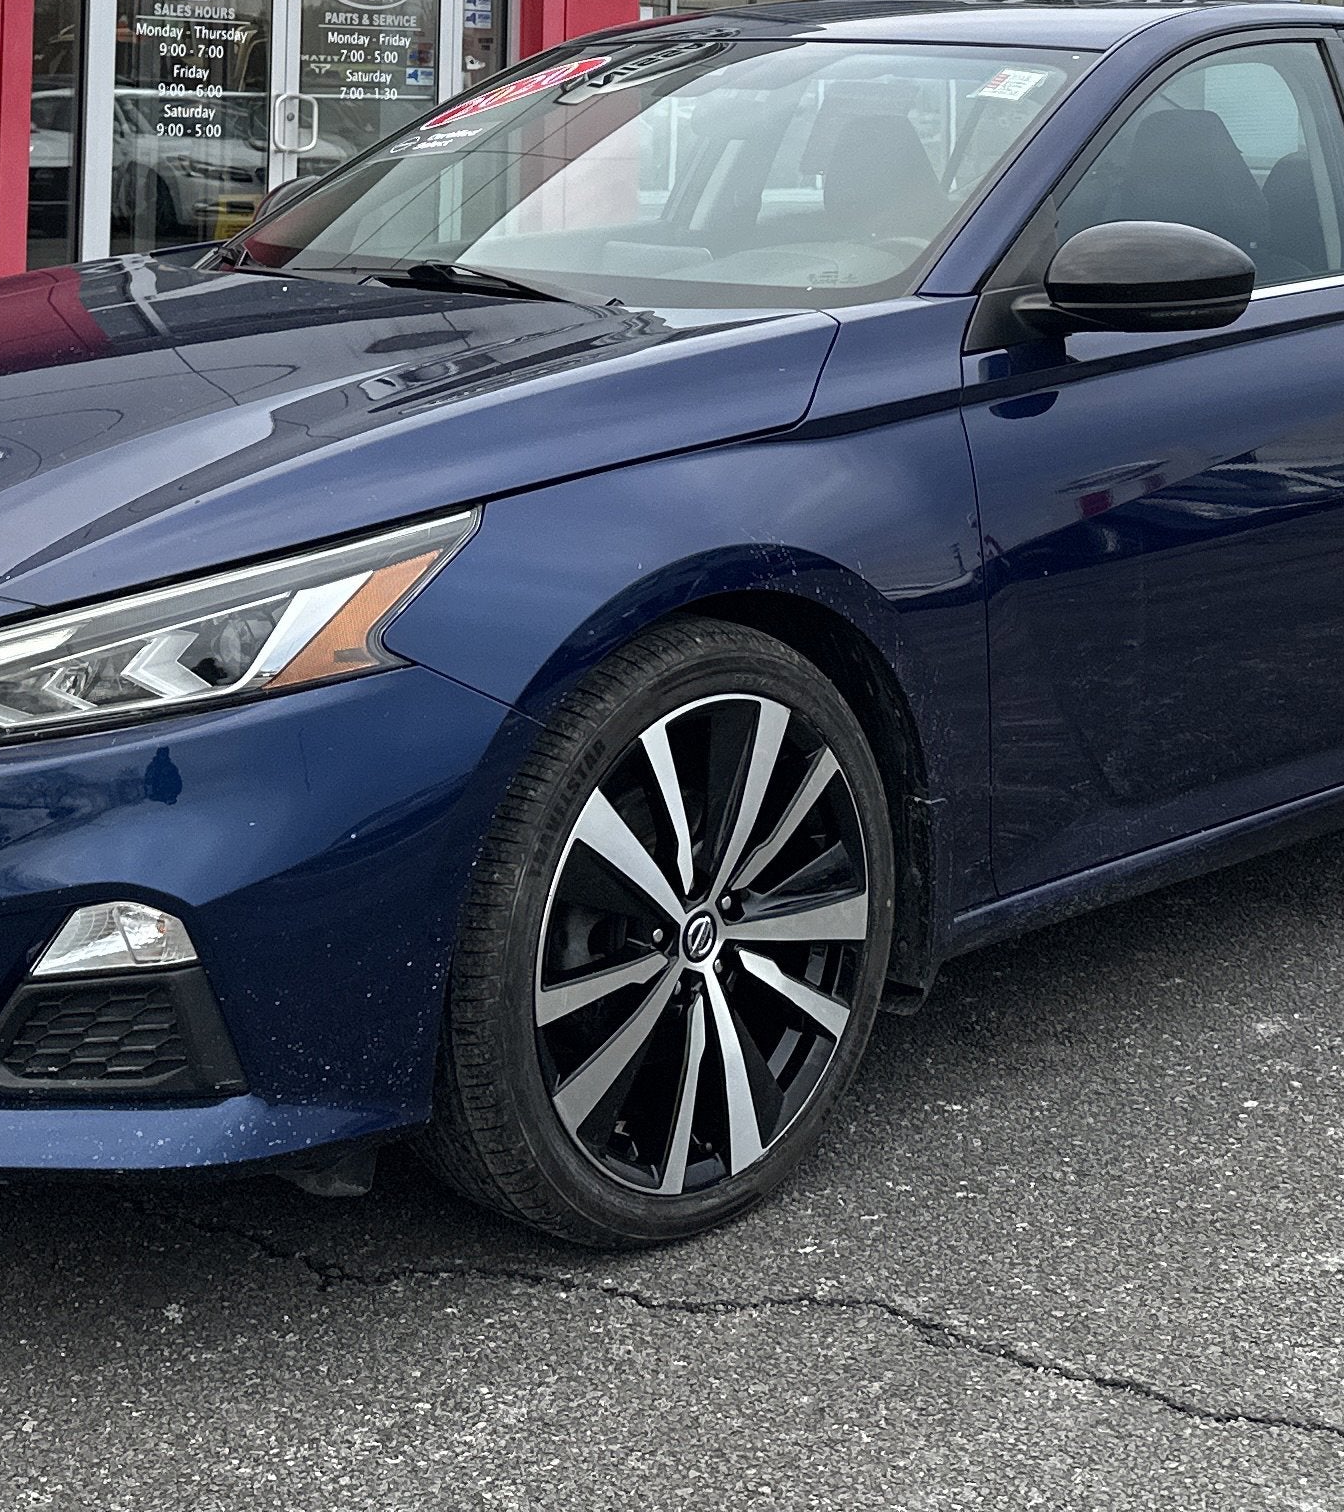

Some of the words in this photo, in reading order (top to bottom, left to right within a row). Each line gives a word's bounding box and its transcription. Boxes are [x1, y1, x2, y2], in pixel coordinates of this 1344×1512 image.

[154, 3, 191, 17] SALES
[195, 6, 235, 19] HOURS
[325, 12, 358, 25] PARTS
[362, 14, 370, 25] &
[372, 14, 417, 27] SERVICE
[136, 23, 183, 40] Monday
[194, 26, 248, 43] Thursday
[327, 31, 370, 47] Monday
[379, 33, 411, 49] Friday
[159, 43, 186, 57] 9:00
[198, 44, 224, 58] 7:00
[340, 49, 364, 63] 7:00
[375, 51, 398, 64] 5:00
[173, 65, 209, 81] Friday
[346, 70, 392, 84] Saturday
[158, 83, 185, 97] 9:00
[196, 85, 223, 98] 6:00
[340, 88, 364, 100] 7:00
[164, 104, 215, 121] Saturday
[156, 123, 184, 137] 9:00
[195, 124, 222, 137] 5:00
